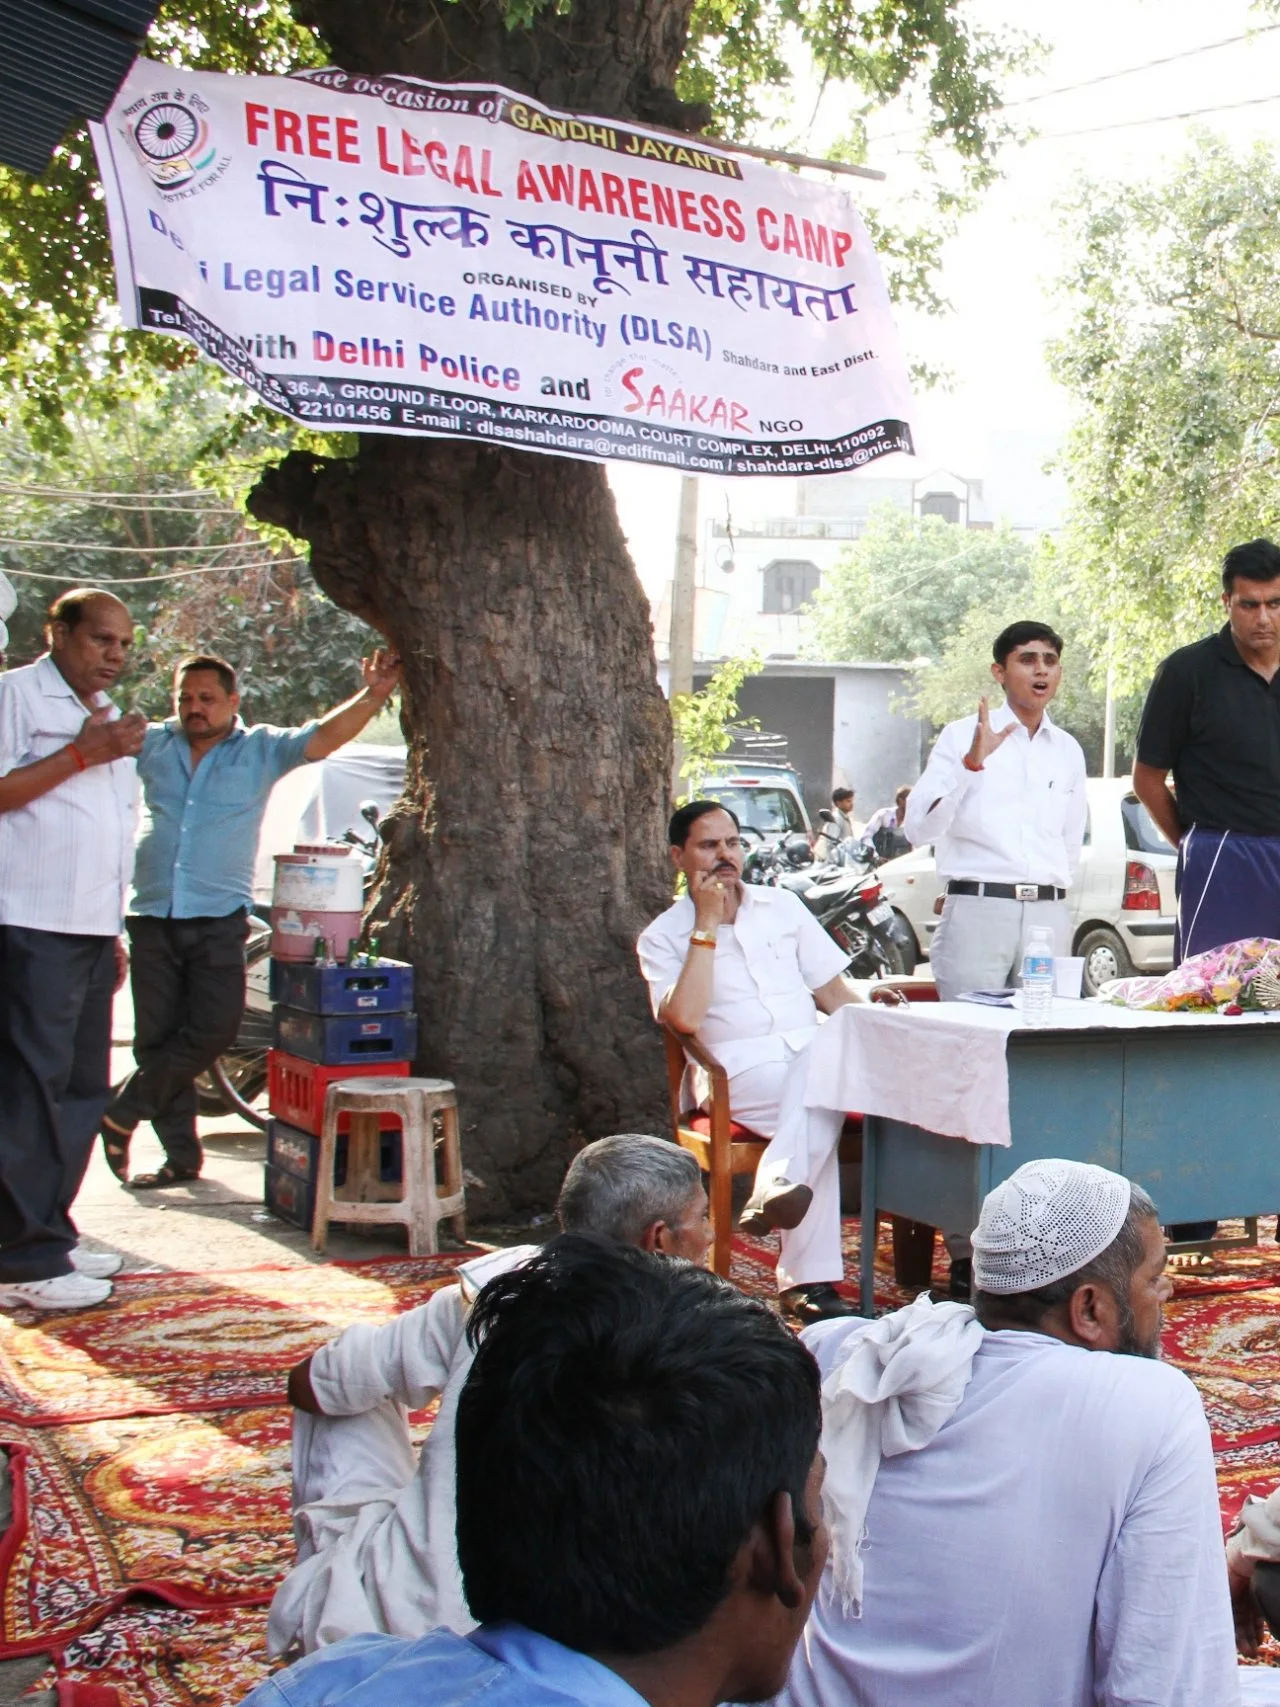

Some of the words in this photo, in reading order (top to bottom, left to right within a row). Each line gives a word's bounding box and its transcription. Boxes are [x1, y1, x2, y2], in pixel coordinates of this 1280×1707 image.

[354, 78, 469, 112] occasion
[477, 96, 508, 123] of
[510, 106, 618, 151] GANDHI
[625, 136, 738, 178] JAYANTI
[244, 102, 361, 164] FREE
[376, 126, 502, 198] LEGAL
[516, 160, 746, 243] AWARENESS
[756, 207, 853, 268] CAMP
[224, 262, 320, 299] Legal
[334, 268, 456, 317] Service
[469, 293, 607, 348] Authority
[620, 313, 712, 362] (DLSA)
[722, 350, 779, 374] Shahdara
[784, 365, 806, 376] and
[811, 362, 840, 377] East
[844, 350, 880, 368] Distt.
[463, 272, 572, 300] ORGANISED
[577, 292, 599, 308] BY
[506, 219, 670, 297] कानूनी
[682, 254, 859, 322] सहायता
[286, 381, 335, 401] 36-A,
[340, 383, 425, 406] GROUND
[429, 393, 496, 418] FLOOR,
[501, 405, 637, 438] KARKARDOOMA
[638, 421, 693, 448] COURT
[697, 435, 778, 459] COMPLEX,
[781, 425, 886, 458] DELHI-110092
[312, 331, 404, 369] Delhi
[419, 343, 520, 391] Police
[540, 374, 591, 400] and
[620, 366, 753, 434] SAAKAR
[759, 420, 803, 433] NGO
[299, 401, 391, 421] 22101456
[402, 411, 461, 432] E-mail
[477, 420, 724, 470] dlsashahdara@rediffmail.com
[736, 437, 910, 474] shahdara-dlsa@nic.in
